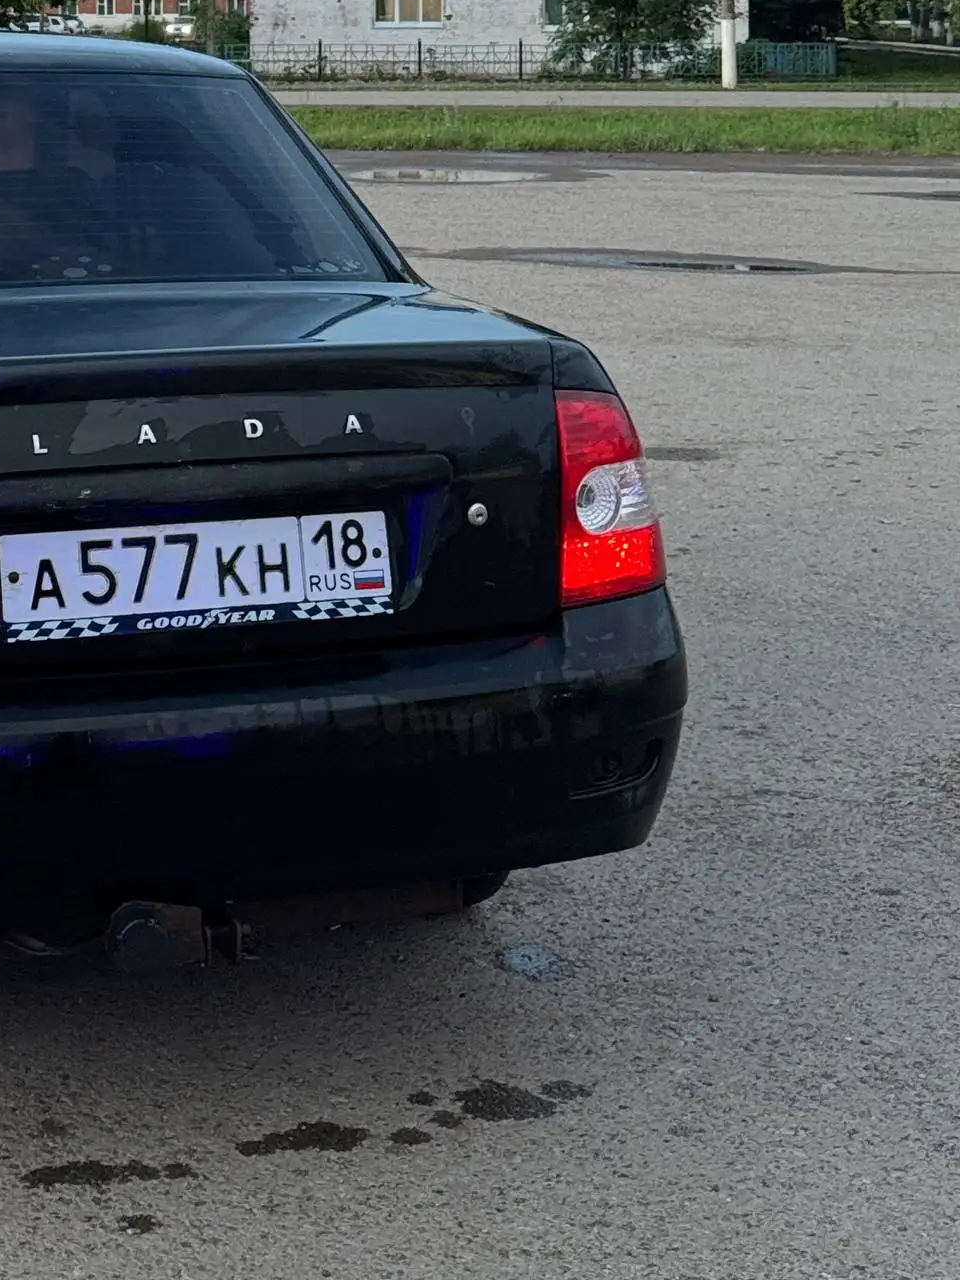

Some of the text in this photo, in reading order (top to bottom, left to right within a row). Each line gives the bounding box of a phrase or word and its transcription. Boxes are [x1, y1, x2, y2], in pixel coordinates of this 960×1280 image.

[31, 414, 364, 455] LADA
[311, 518, 368, 570] 18
[309, 572, 352, 593] RUS
